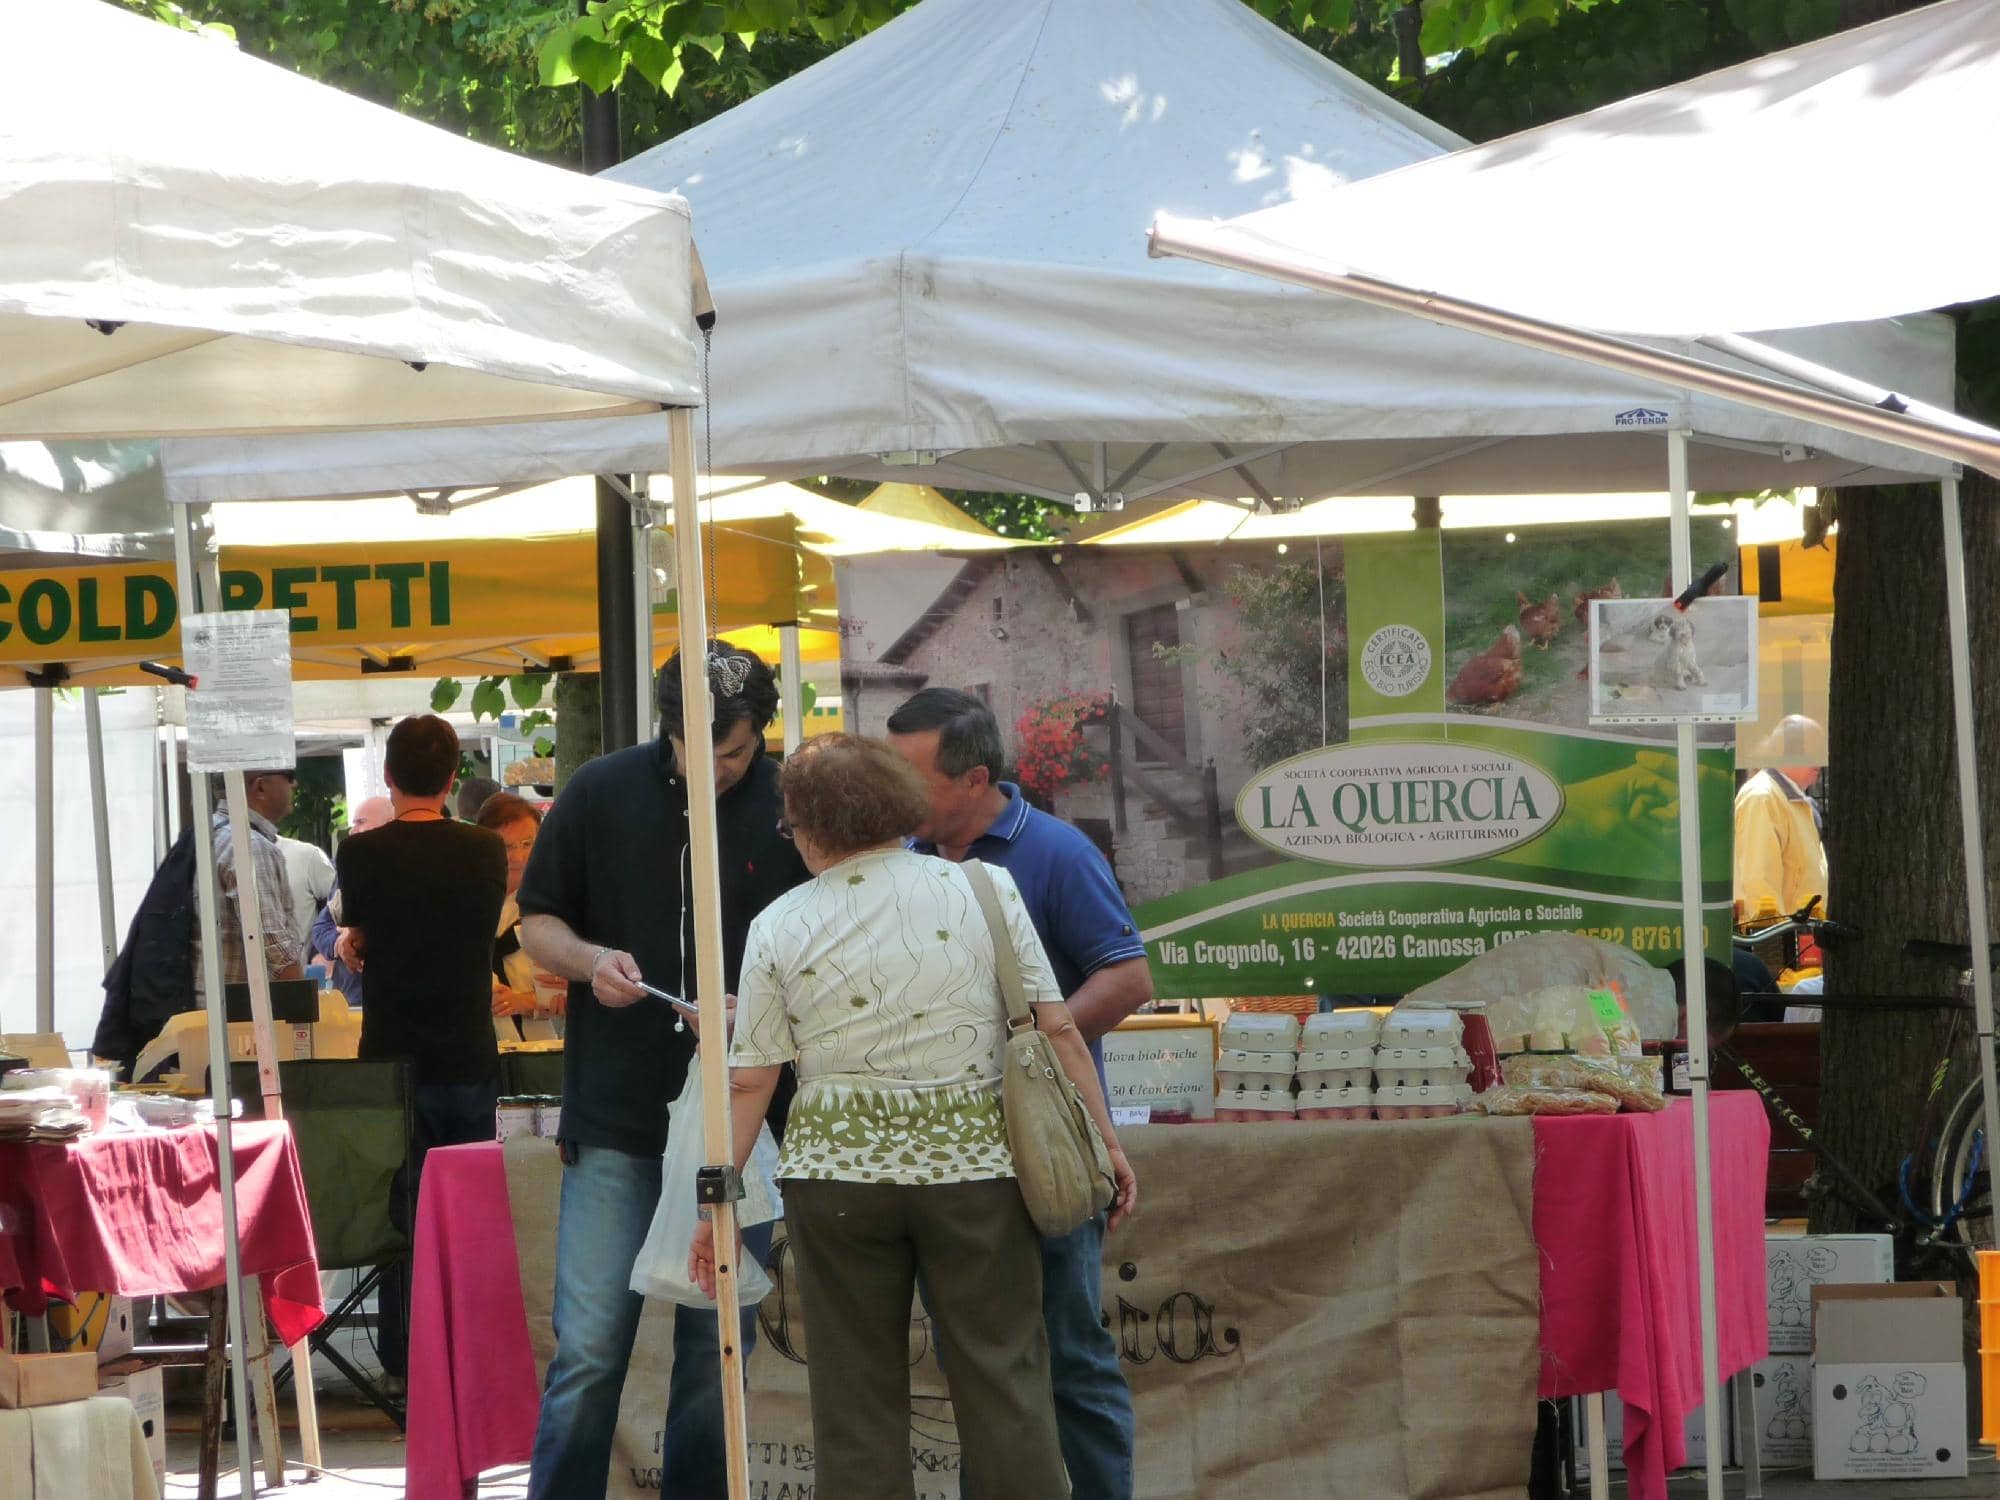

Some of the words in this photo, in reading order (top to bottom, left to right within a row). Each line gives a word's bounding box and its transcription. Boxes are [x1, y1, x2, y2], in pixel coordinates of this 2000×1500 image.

[0, 560, 451, 647] OLDRETTI
[1367, 628, 1425, 653] CERTIFICATO
[1380, 654, 1415, 665] ICEA
[1329, 765, 1402, 778] COOPERATIVA
[1405, 763, 1459, 776] AGRICOLA
[1471, 762, 1514, 773] SOCIALE
[1259, 783, 1321, 829] LA
[1332, 775, 1542, 834] QUERCIA
[1284, 834, 1341, 847] AZIENDA
[1345, 831, 1415, 845] BIOLOGICA
[1428, 827, 1519, 842] AGRITURISMO
[1263, 912, 1277, 929] LA
[1281, 911, 1336, 933] QUERCIA
[1388, 905, 1463, 929] Cooperativa
[1467, 905, 1521, 927] Agricola
[1524, 908, 1533, 921] e
[1536, 903, 1583, 920] Sociale
[1158, 941, 1189, 965] Via
[1194, 938, 1284, 970] Crognolo,
[1291, 937, 1315, 961] 16
[1335, 934, 1396, 961] 42026
[1402, 933, 1486, 959] Canossa
[1138, 1048, 1198, 1062] biologiche
